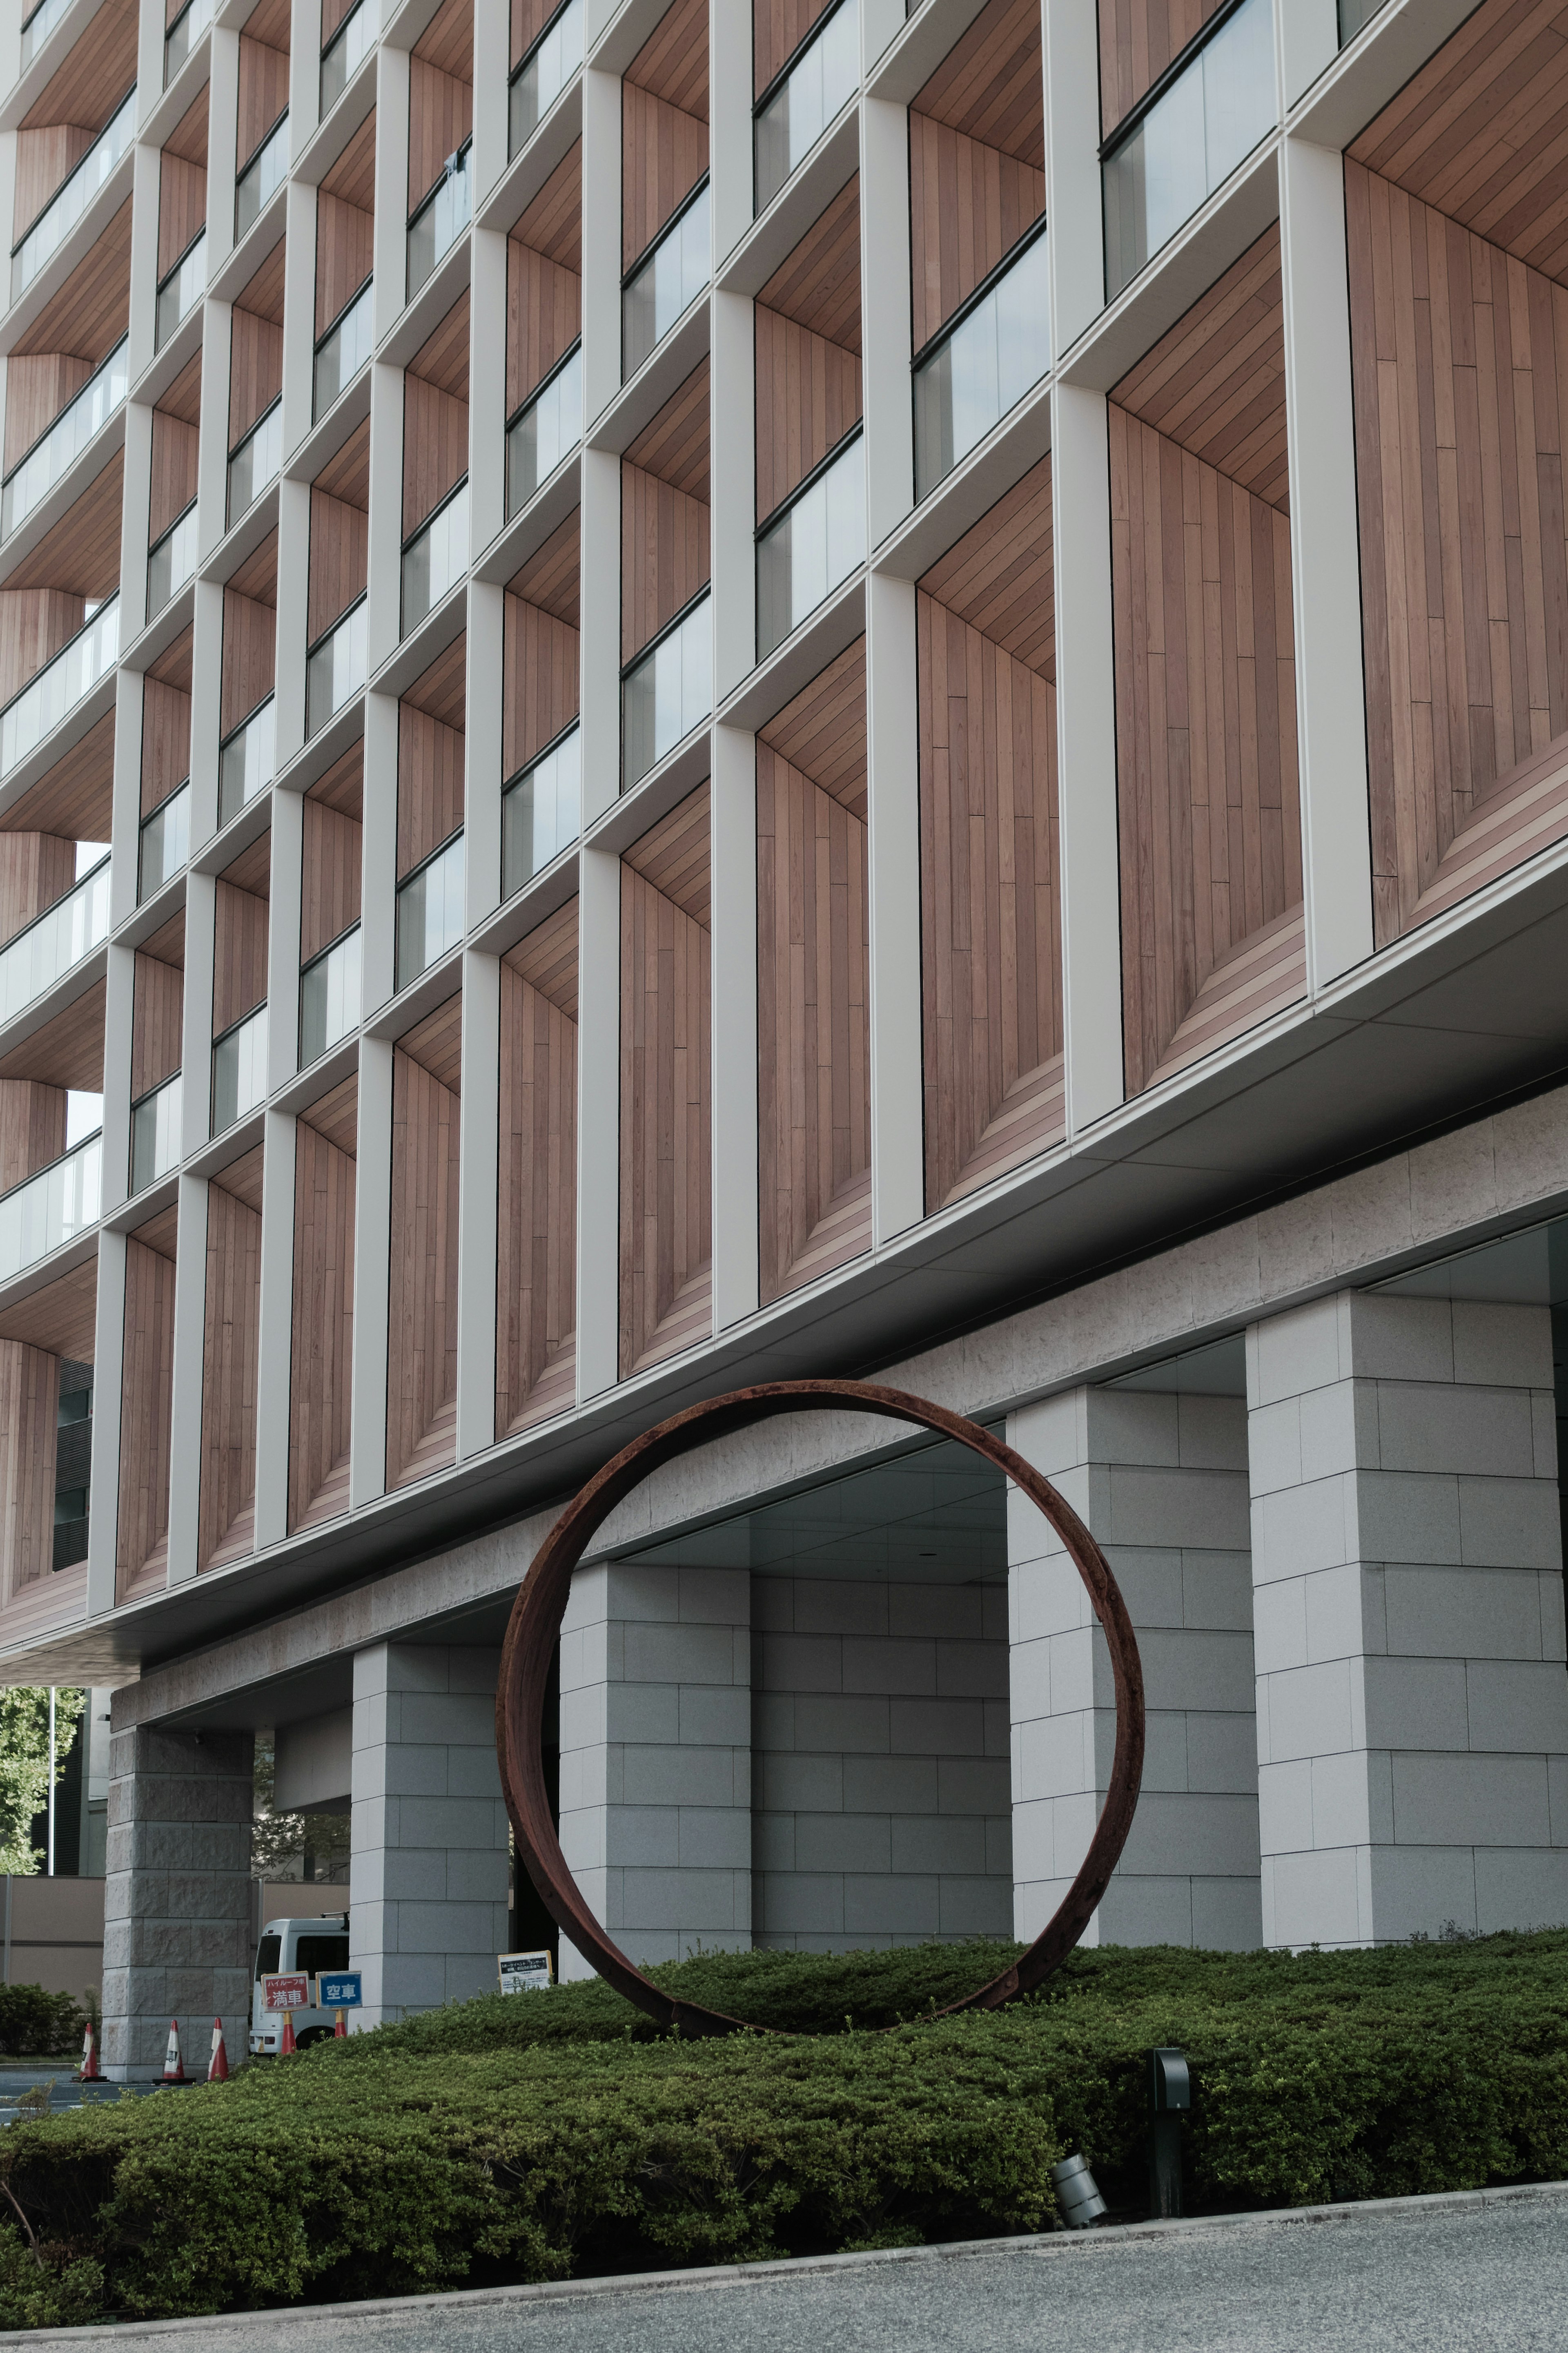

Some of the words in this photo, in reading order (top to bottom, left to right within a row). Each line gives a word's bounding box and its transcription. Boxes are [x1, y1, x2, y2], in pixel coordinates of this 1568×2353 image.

[268, 1978, 305, 1987] ハイルーフ車
[272, 1989, 303, 2006] 満車
[327, 1984, 356, 2000] 空車
